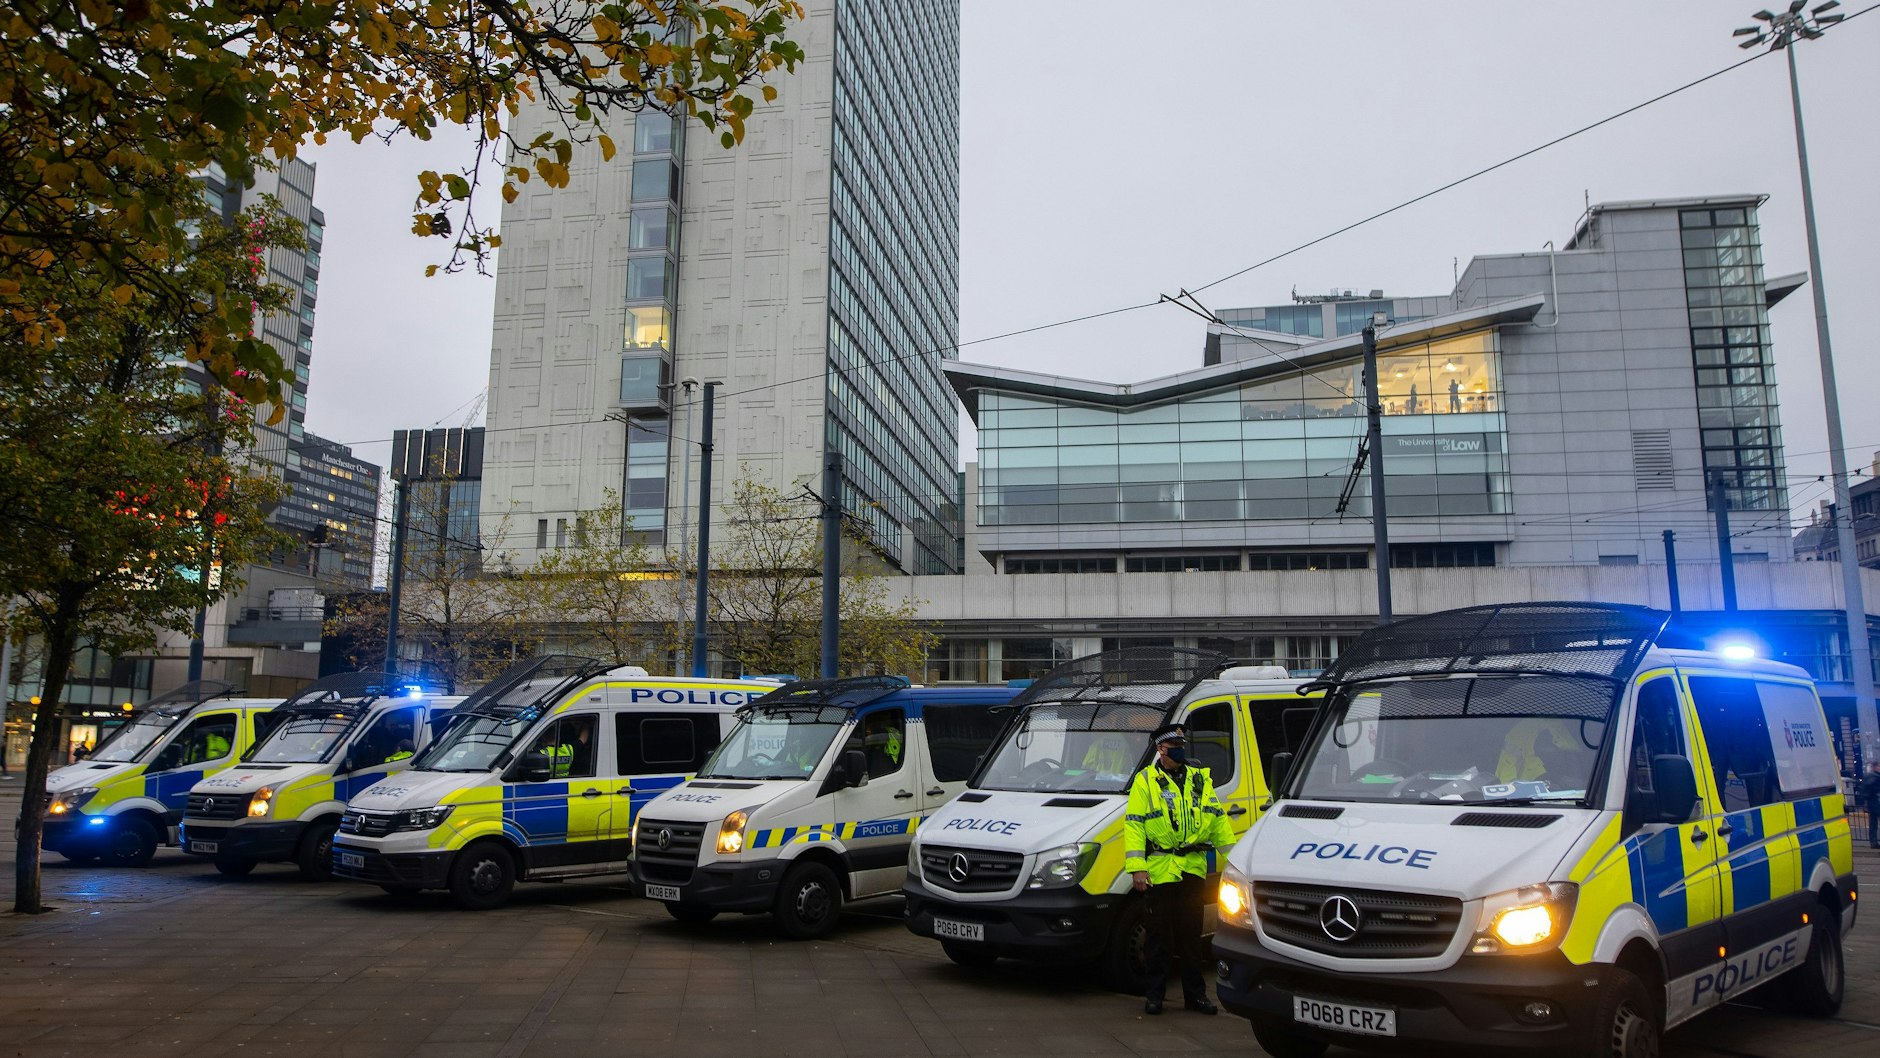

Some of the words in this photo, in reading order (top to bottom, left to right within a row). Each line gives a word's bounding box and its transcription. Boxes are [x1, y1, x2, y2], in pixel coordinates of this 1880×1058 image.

[1398, 439, 1412, 447] The
[1412, 438, 1450, 446] University
[1451, 440, 1480, 451] Law
[321, 453, 355, 470] Manchester
[356, 464, 369, 475] One
[1792, 730, 1816, 748] POLICE
[203, 777, 242, 788] POLICE
[365, 786, 408, 797] POLICE
[667, 794, 722, 803] POLICE
[862, 824, 899, 836] POLICE
[943, 818, 1021, 835] POLICE
[1290, 843, 1438, 869] POLICE
[664, 887, 678, 899] ERK
[937, 920, 958, 935] PO68
[960, 924, 979, 938] CRV
[1692, 937, 1797, 1006] POLICE
[1300, 1000, 1344, 1025] PO68
[1349, 1009, 1387, 1032] CRZ
